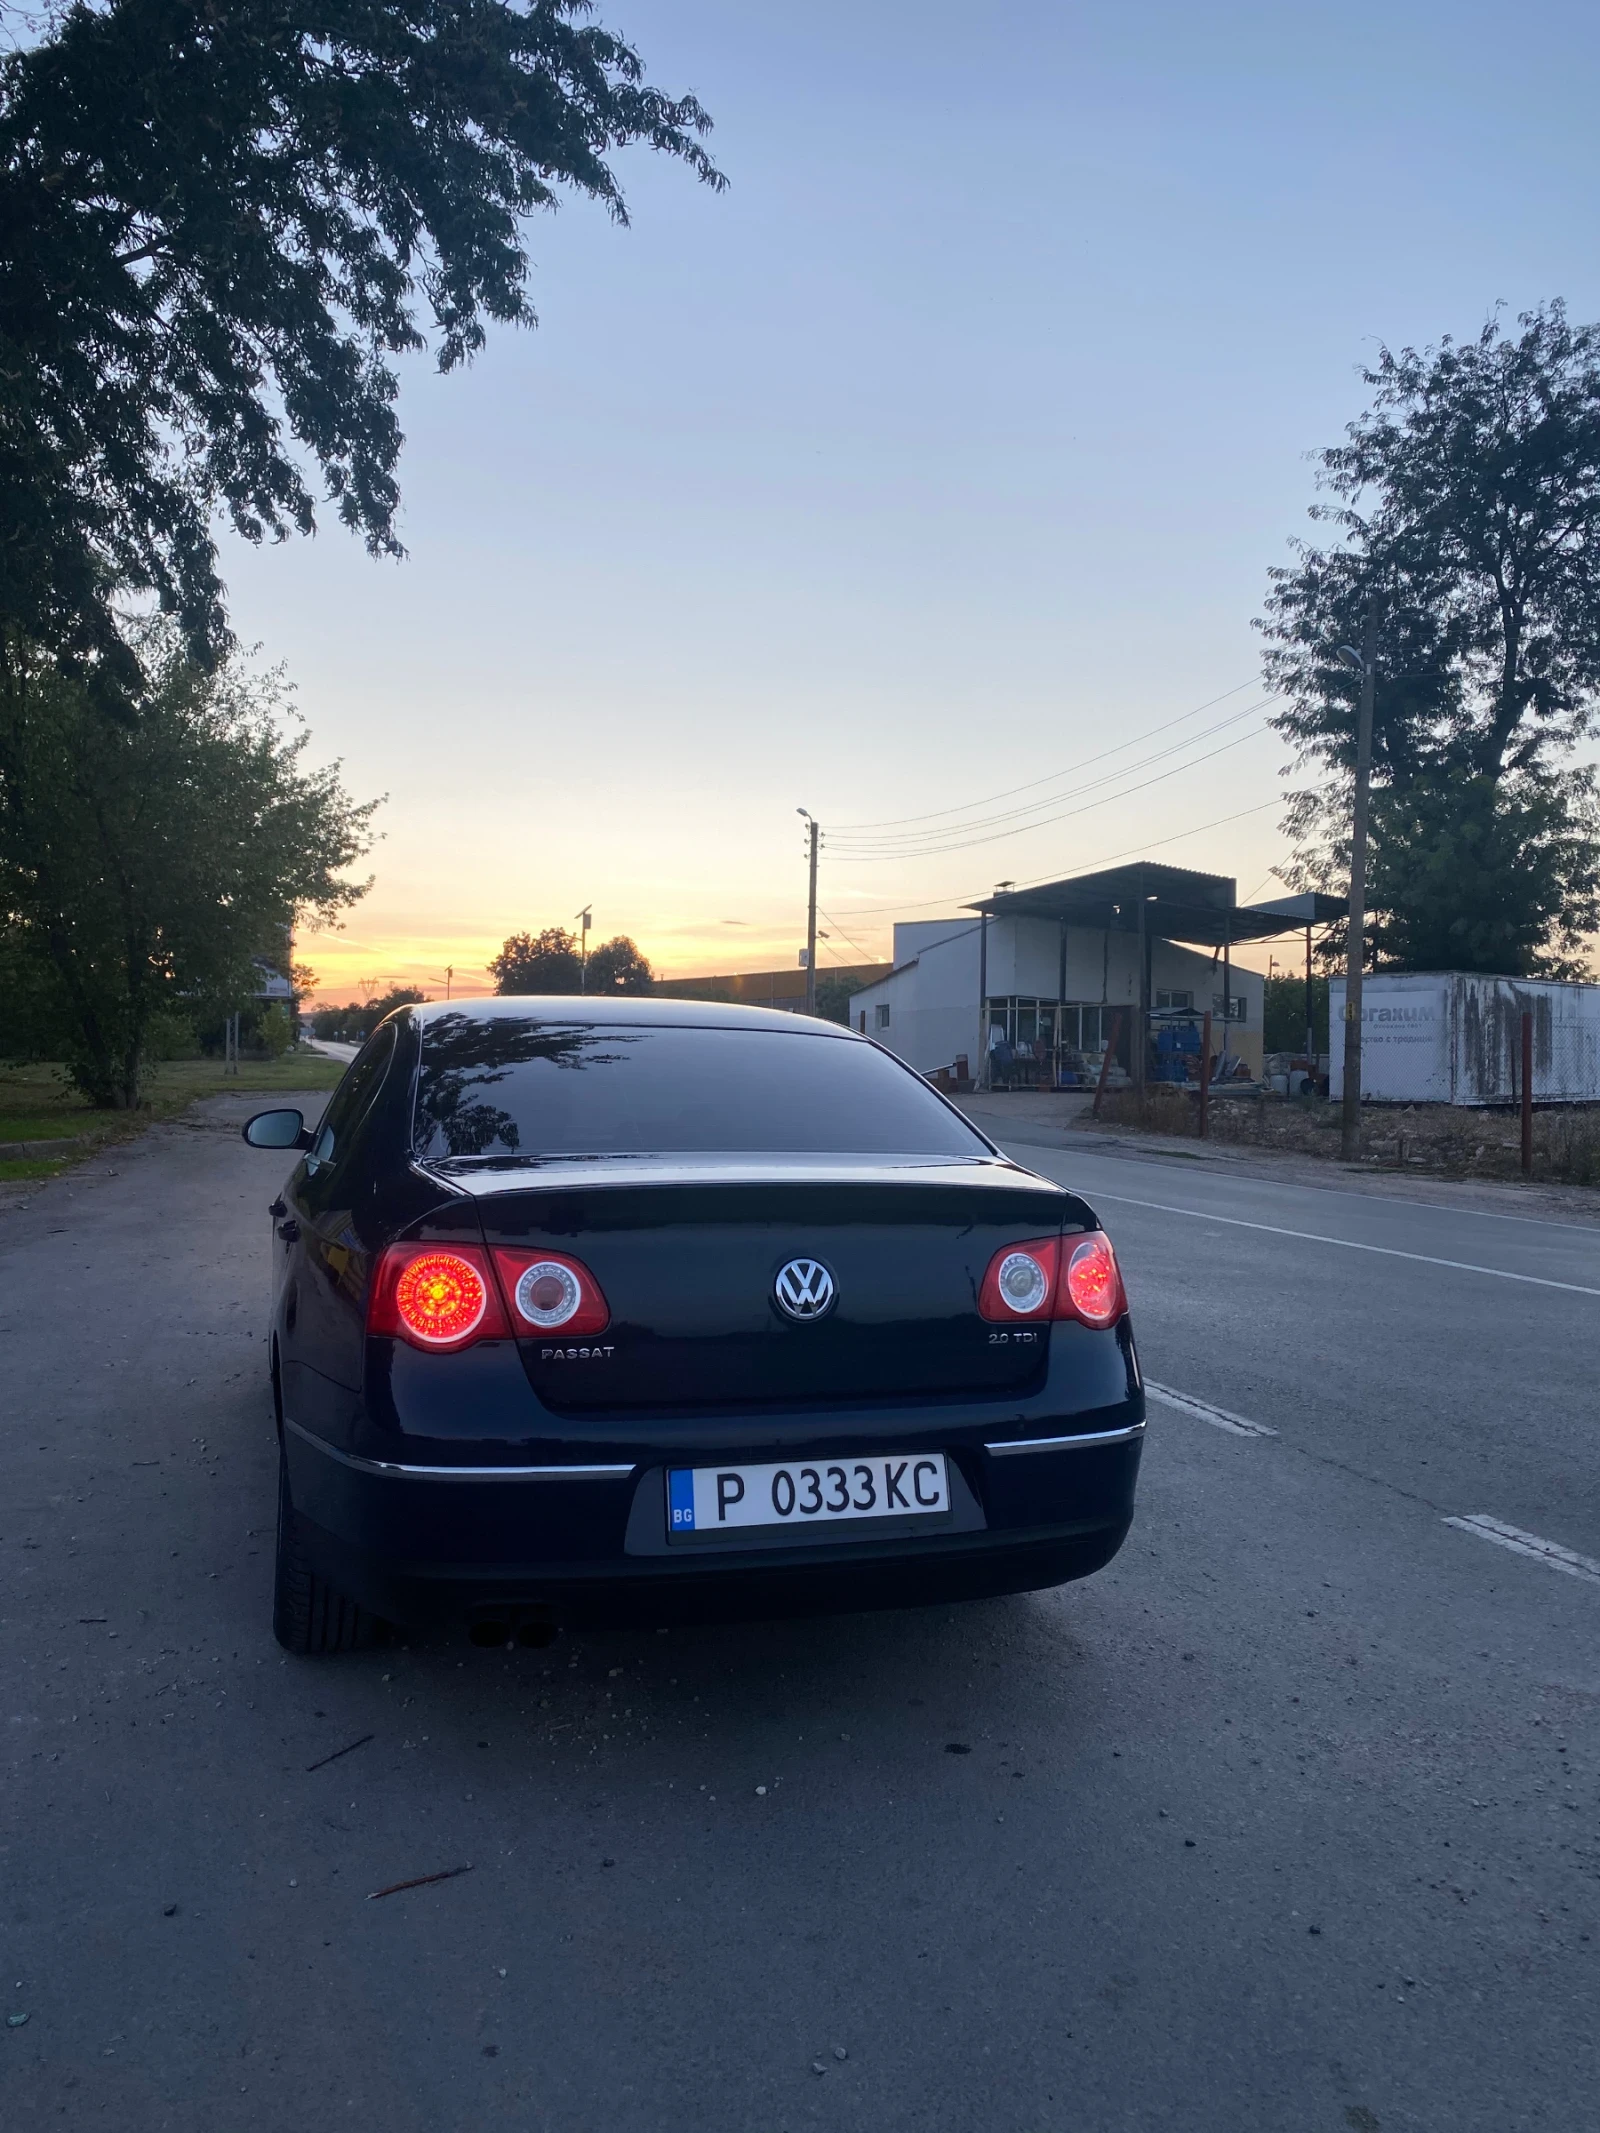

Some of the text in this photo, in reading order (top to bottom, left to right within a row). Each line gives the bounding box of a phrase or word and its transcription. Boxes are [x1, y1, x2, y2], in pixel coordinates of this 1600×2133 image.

[1013, 1332, 1038, 1343] TDI
[541, 1346, 615, 1360] PASSAT
[716, 1472, 745, 1522] P
[673, 1508, 693, 1523] BG
